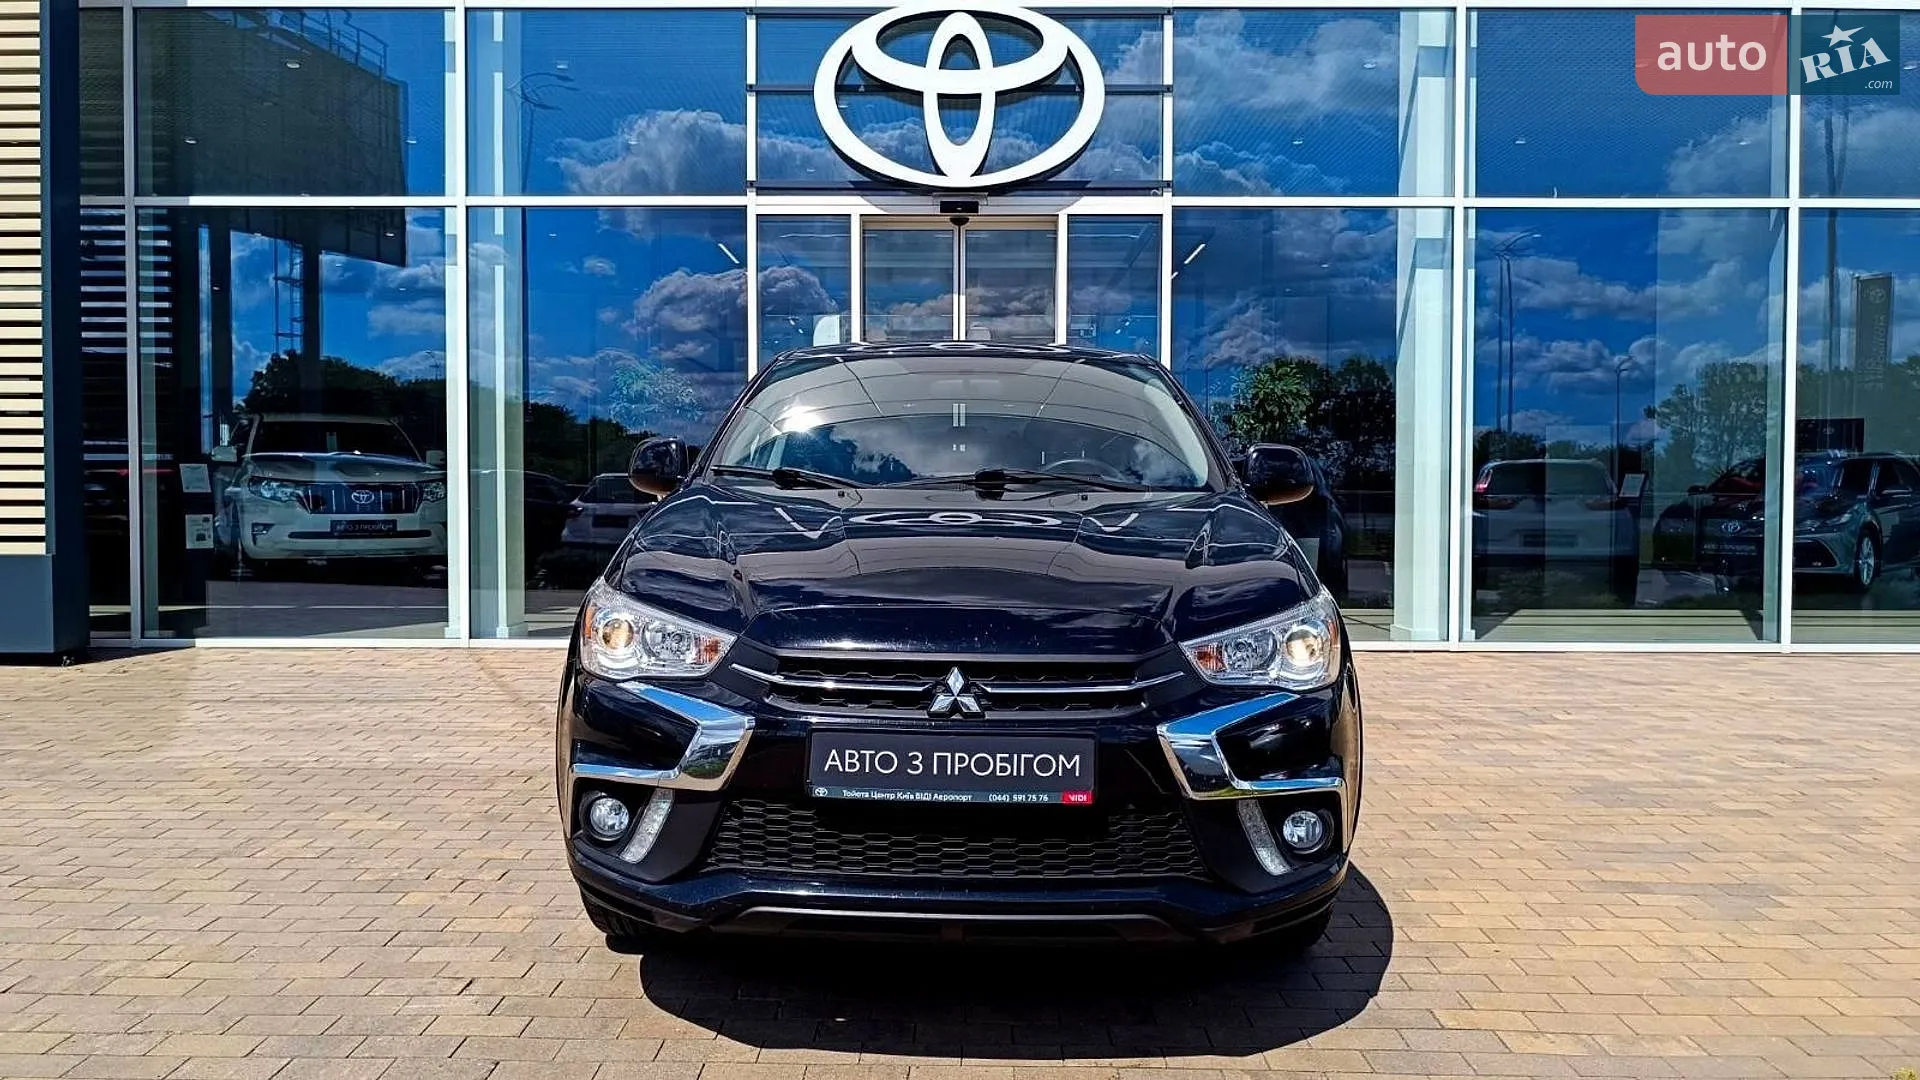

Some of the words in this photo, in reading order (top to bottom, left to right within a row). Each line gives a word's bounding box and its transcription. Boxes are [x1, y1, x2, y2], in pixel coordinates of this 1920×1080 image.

[824, 749, 898, 774] АВТО
[933, 752, 1080, 777] ПРОБІГОМ
[842, 789, 870, 798] Тойота
[871, 791, 895, 800] Центр
[896, 791, 914, 800] Київ
[933, 793, 973, 802] Аеропорт
[988, 793, 1010, 802] (044)
[1013, 794, 1026, 802] 591
